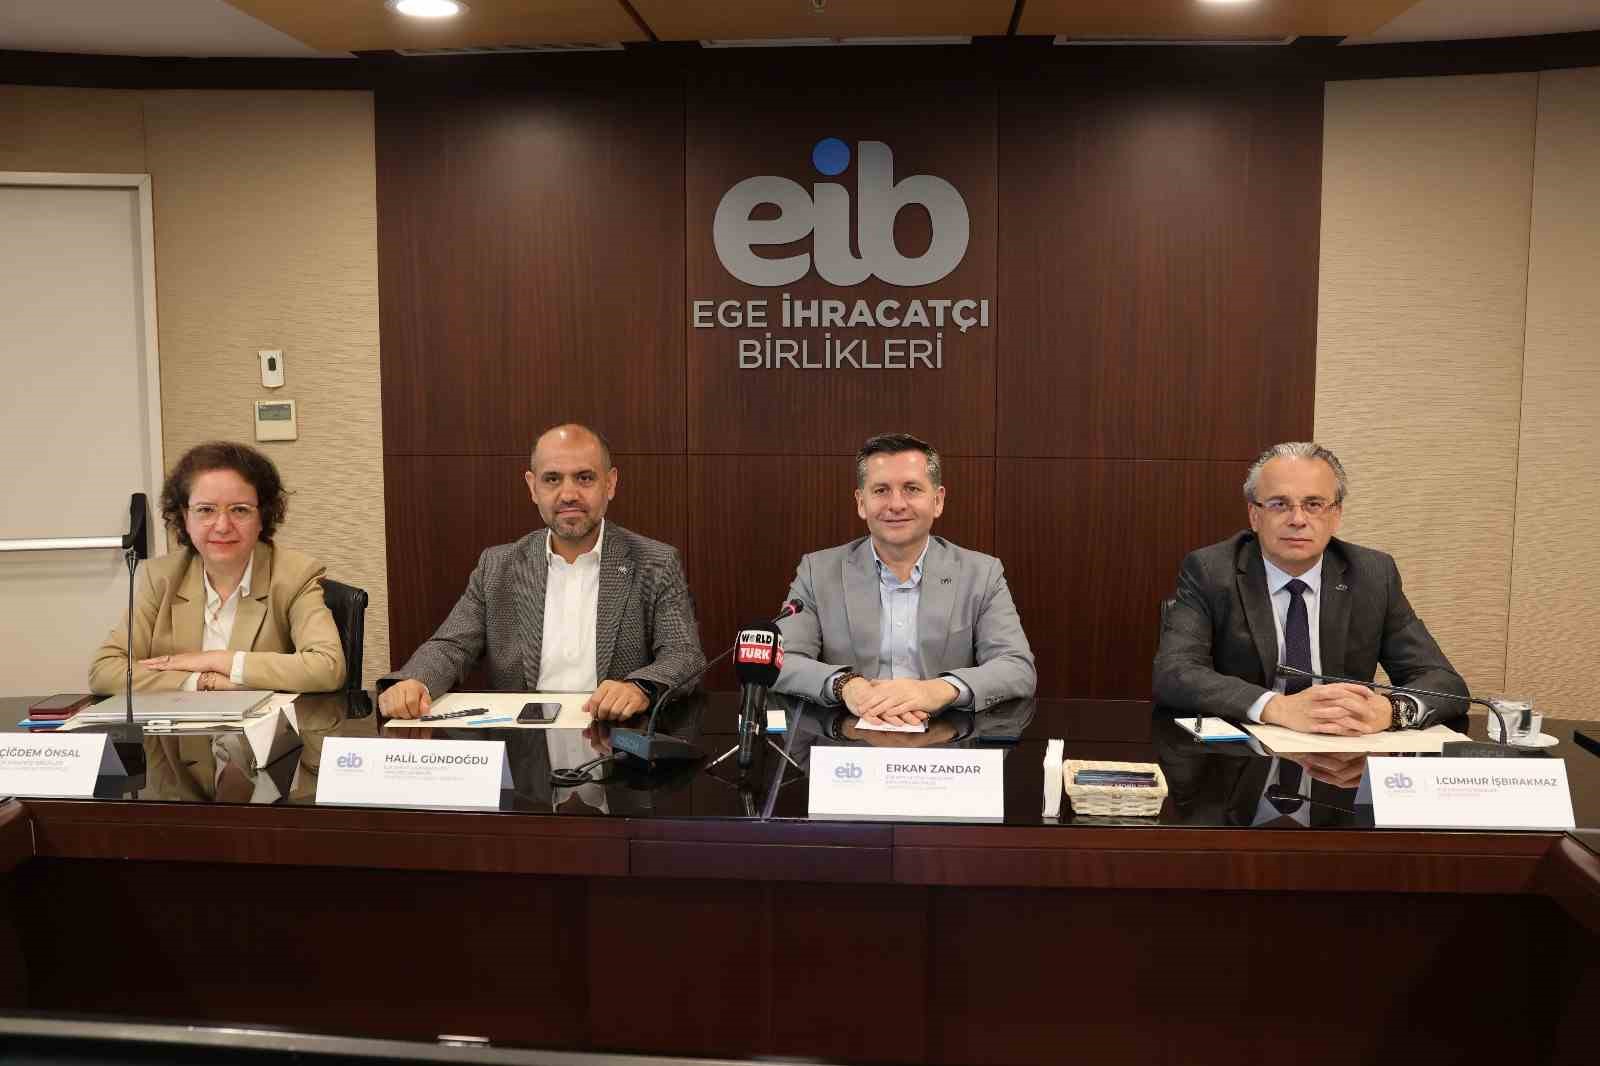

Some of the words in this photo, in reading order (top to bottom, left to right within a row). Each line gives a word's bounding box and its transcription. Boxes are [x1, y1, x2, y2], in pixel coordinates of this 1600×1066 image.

[713, 137, 970, 287] eib
[692, 300, 768, 329] EGE
[782, 293, 990, 333] İHRACATÇI
[738, 332, 943, 370] BİRLİKLERİ
[741, 633, 773, 644] WORLD
[44, 746, 81, 758] ÖNSAL
[336, 752, 363, 769] eib
[384, 753, 418, 765] HALİL
[420, 753, 489, 766] GÜNDOĞDU
[834, 762, 863, 779] eib
[885, 764, 927, 774] ERKAN
[930, 764, 982, 775] ZANDAR
[1384, 771, 1413, 789] eib
